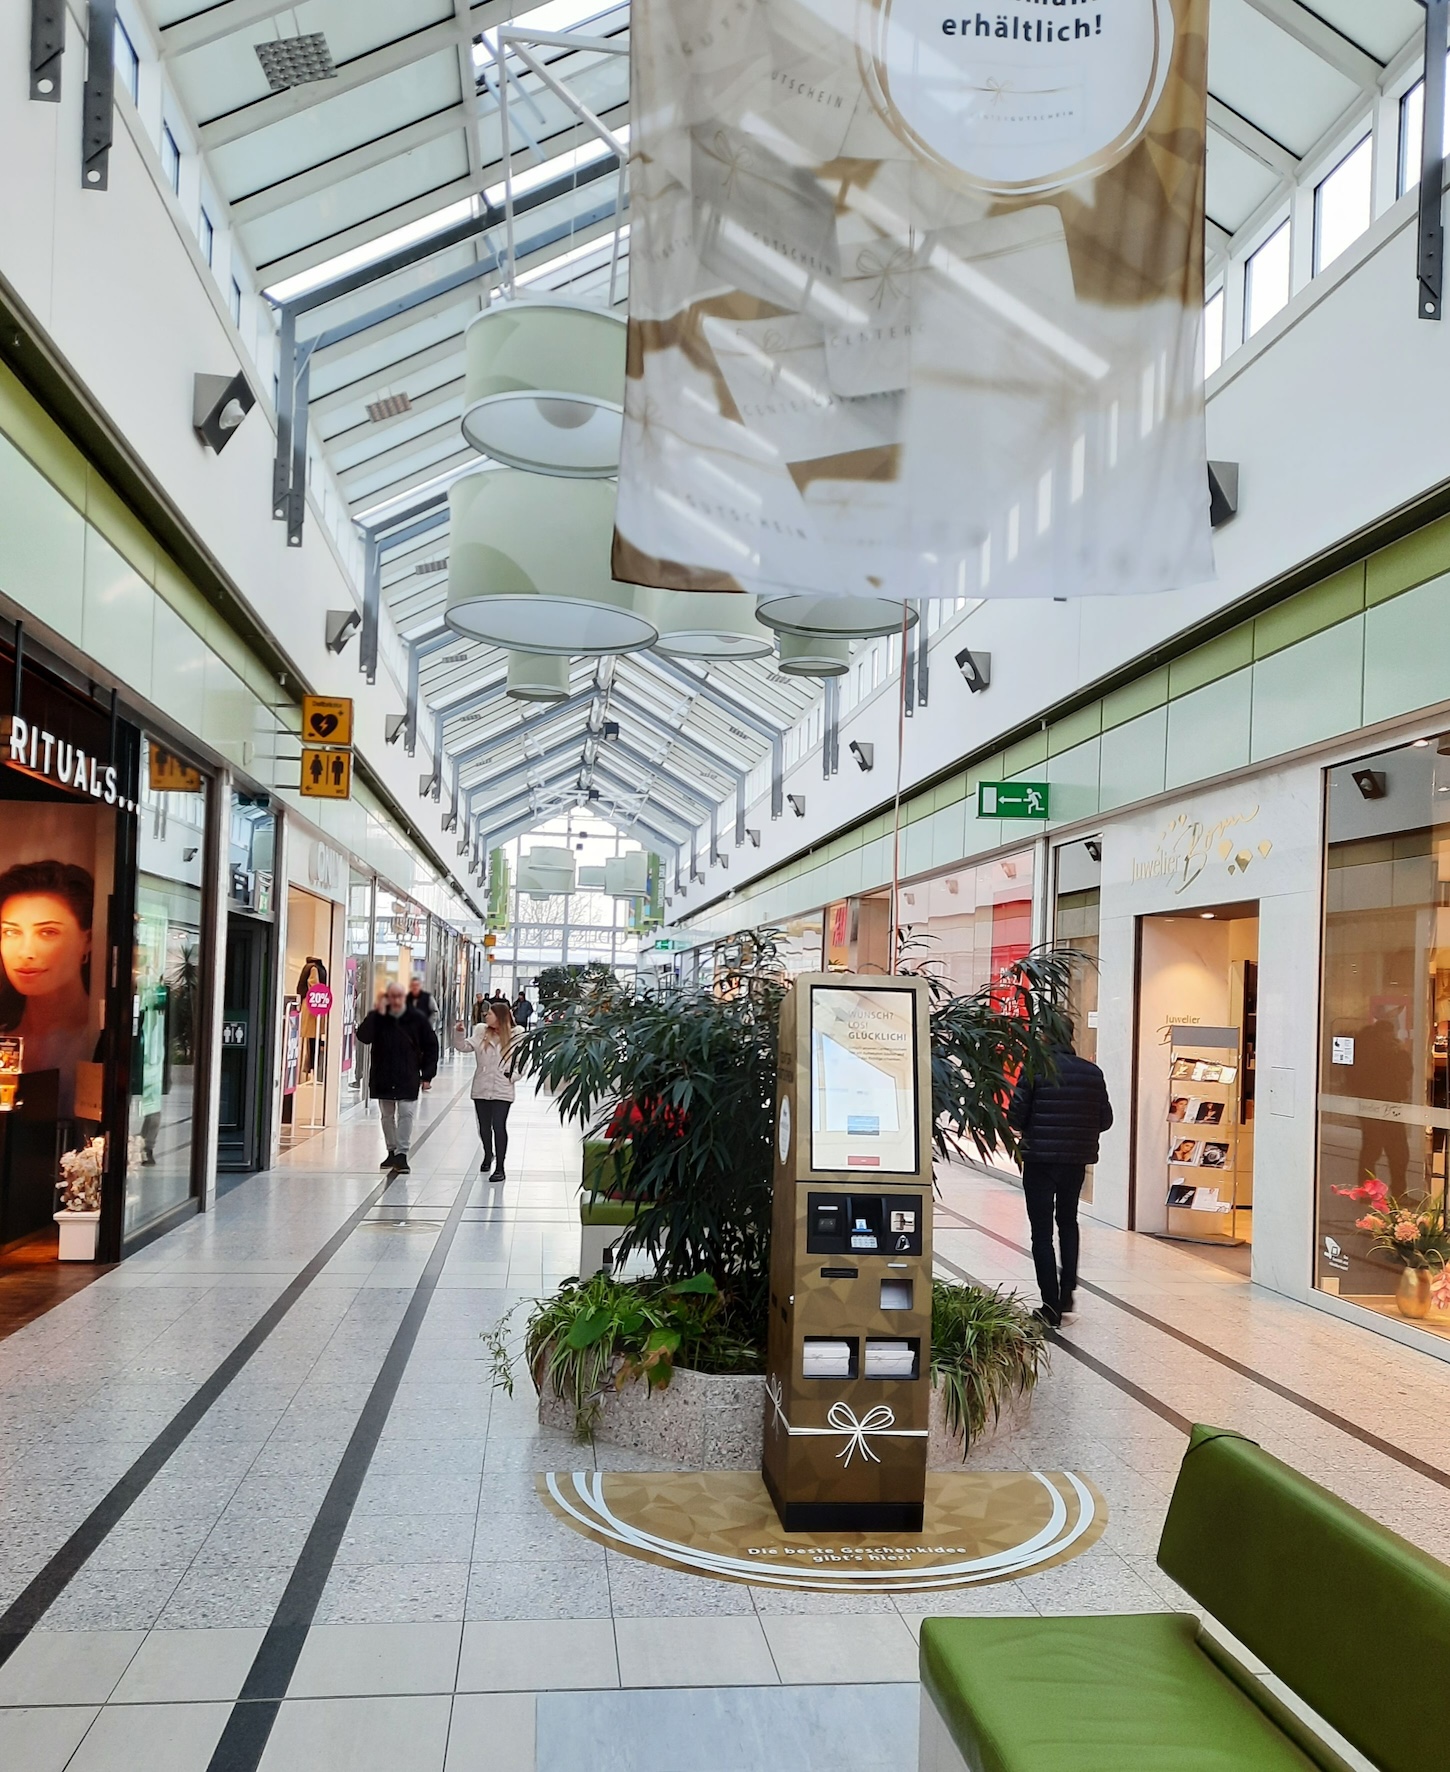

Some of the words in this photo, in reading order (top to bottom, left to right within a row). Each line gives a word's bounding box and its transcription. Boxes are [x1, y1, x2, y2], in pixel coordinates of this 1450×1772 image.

[942, 13, 1102, 43] erhältlich!
[1131, 849, 1181, 886] Juwelier
[309, 992, 330, 1004] 20%
[848, 1011, 894, 1020] WUNSCH?
[1166, 1015, 1201, 1024] Juwelier
[840, 1546, 967, 1554] Geschenkidee
[812, 1554, 862, 1563] gibt's
